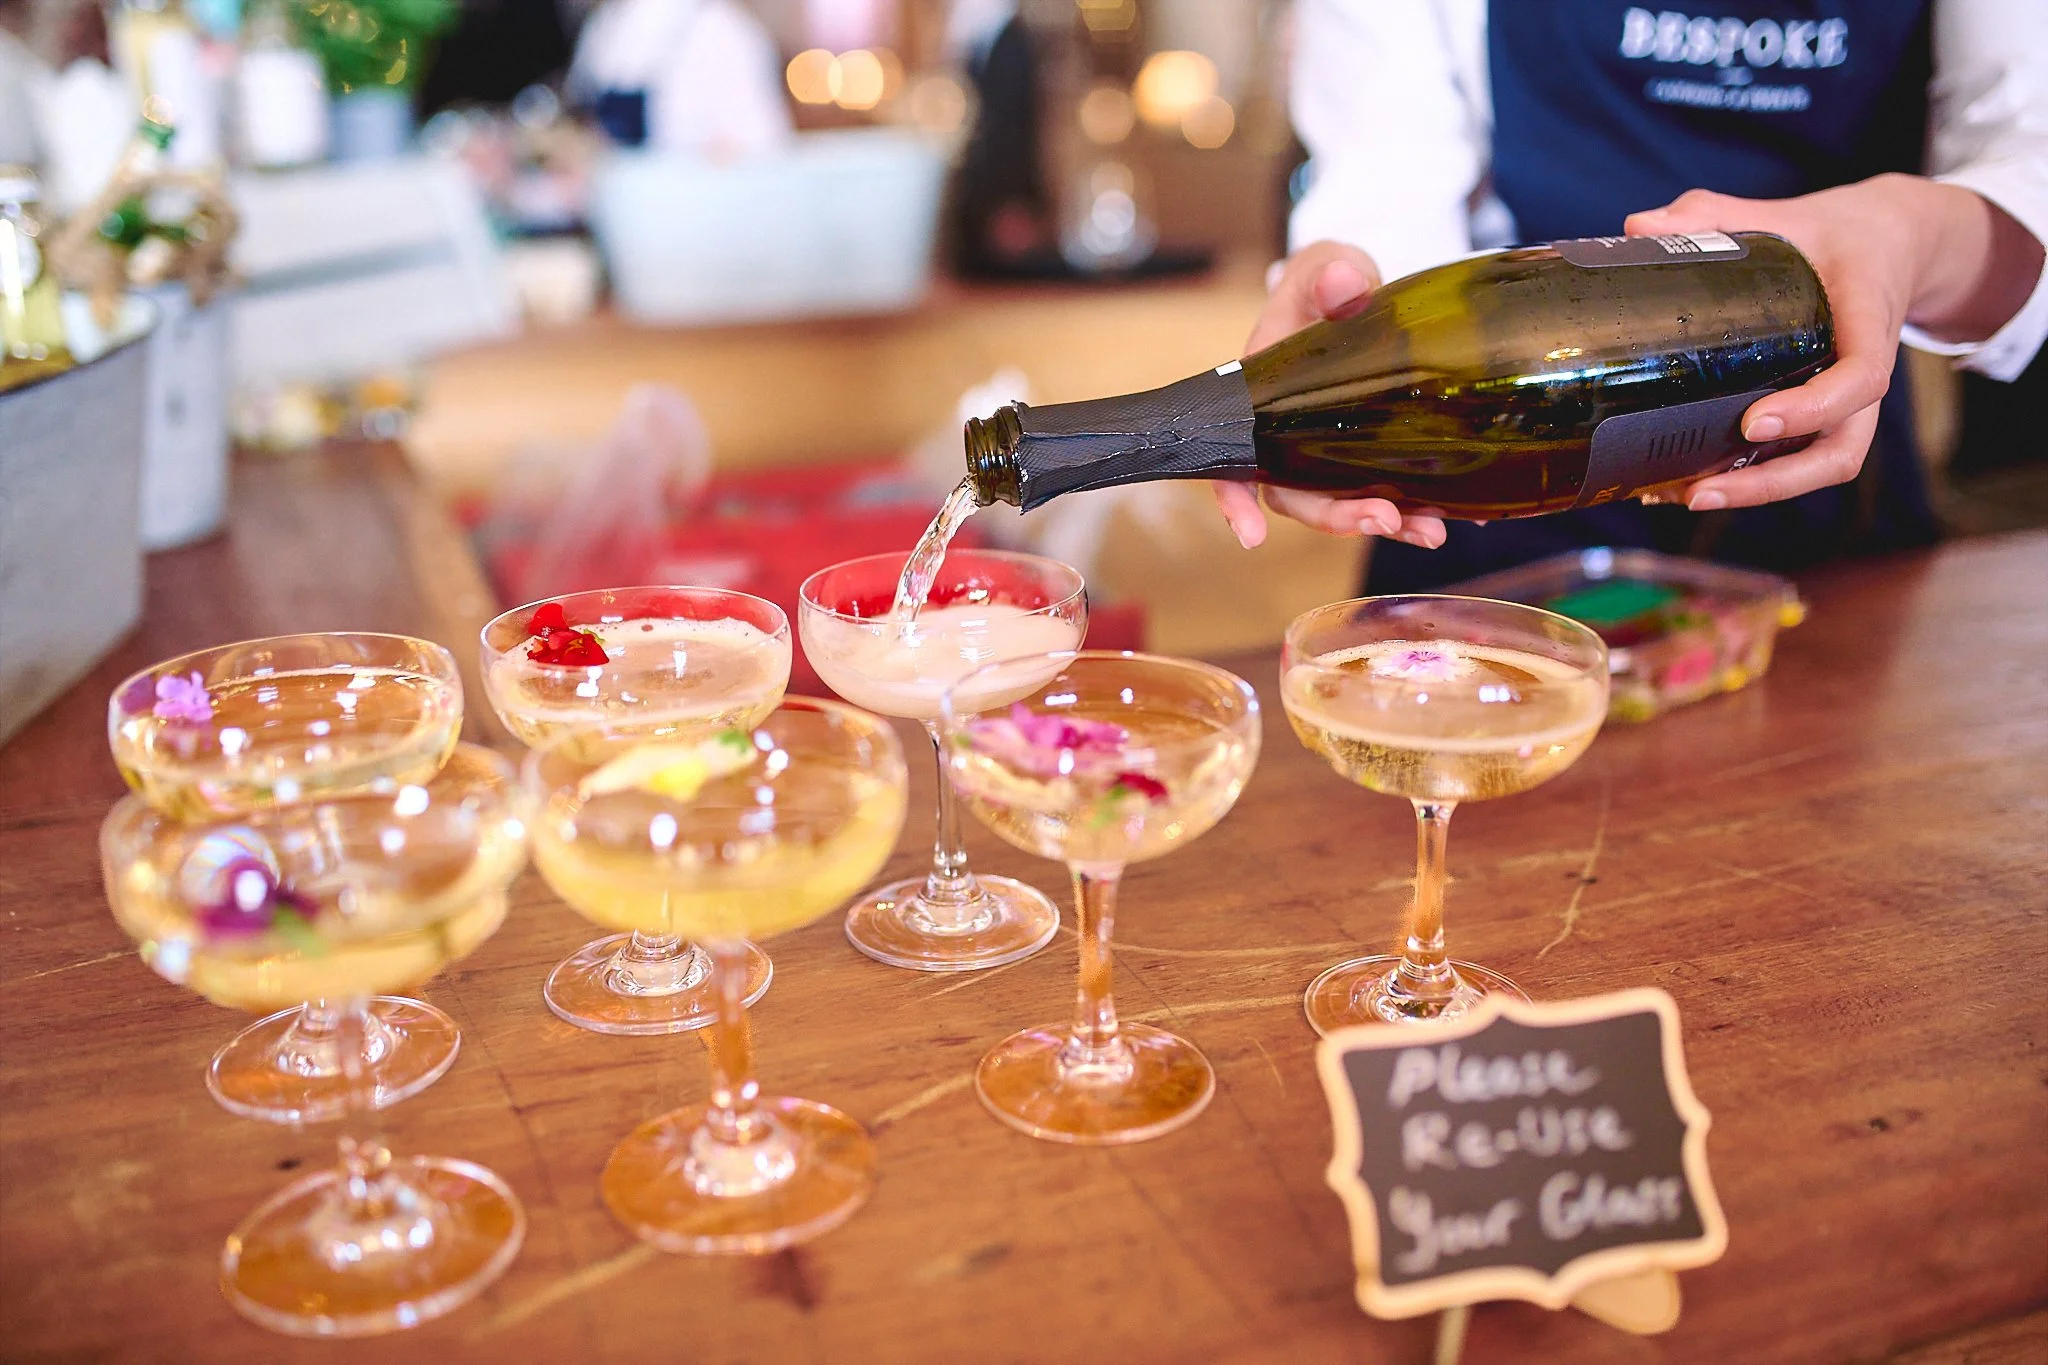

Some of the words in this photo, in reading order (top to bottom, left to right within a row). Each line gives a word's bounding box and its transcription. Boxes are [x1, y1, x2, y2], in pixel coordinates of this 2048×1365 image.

[1620, 7, 1848, 68] BESPOKE
[1388, 1045, 1599, 1107] Please
[1540, 1171, 1683, 1240] Glass
